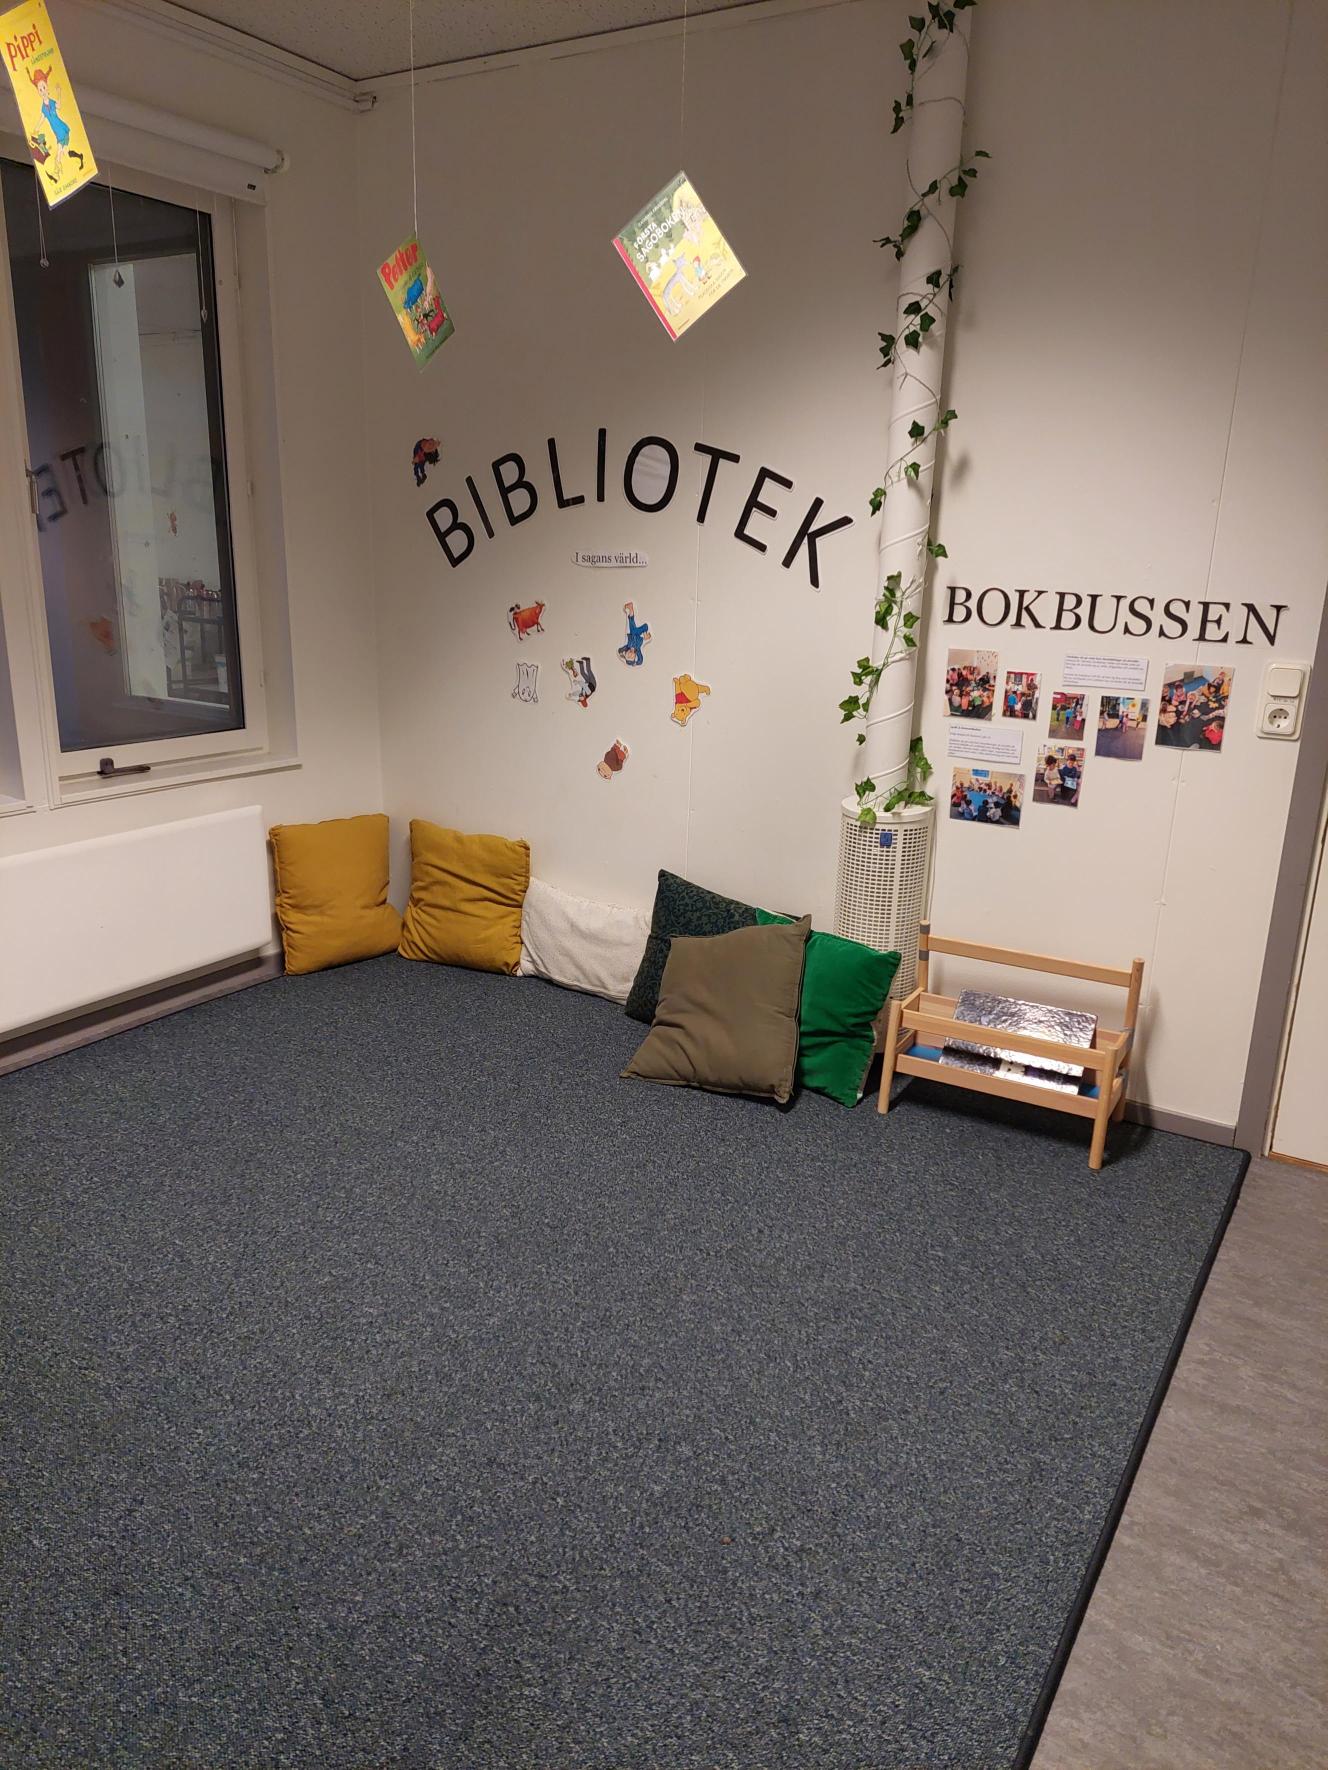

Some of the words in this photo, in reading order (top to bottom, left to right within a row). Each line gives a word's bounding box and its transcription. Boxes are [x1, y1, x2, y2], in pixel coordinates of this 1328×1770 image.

[426, 427, 854, 589] BIBLIOTEK
[575, 552, 579, 563] I
[581, 554, 612, 566] sagans
[614, 552, 647, 565] värld...
[943, 585, 1288, 647] BOKBUSSEN
